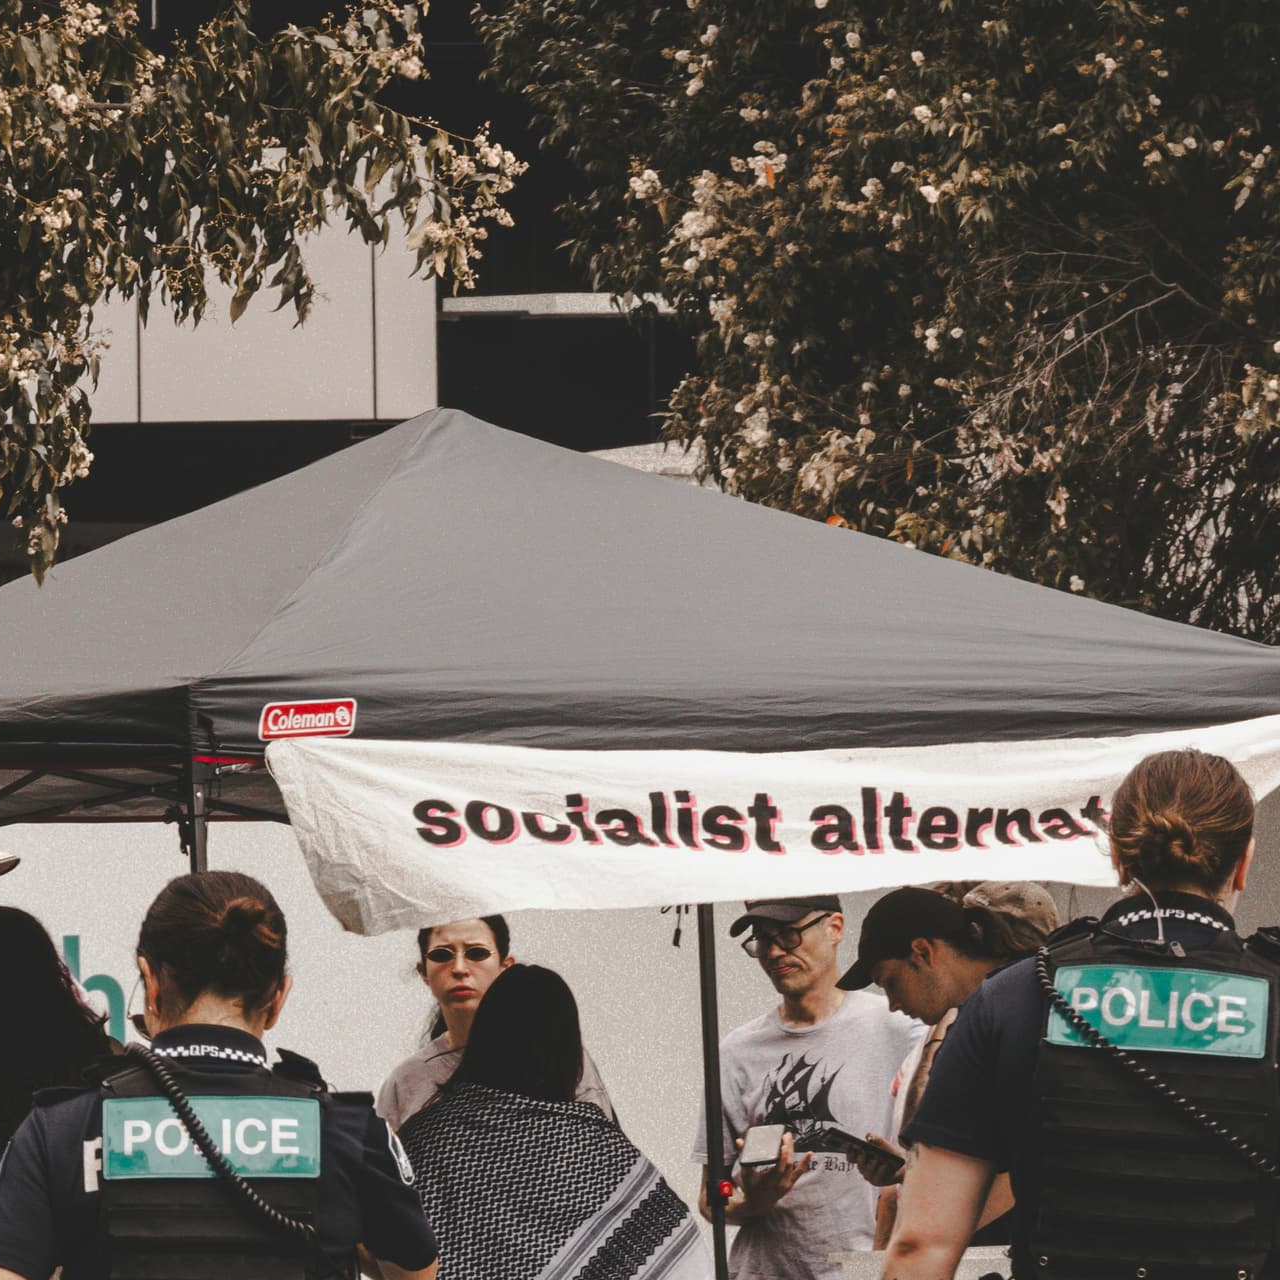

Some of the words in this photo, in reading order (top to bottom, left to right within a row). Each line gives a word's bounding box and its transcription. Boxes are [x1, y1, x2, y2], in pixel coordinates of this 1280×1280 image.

[267, 708, 335, 731] Coleman
[413, 789, 788, 856] socialist
[809, 786, 1110, 856] alternat
[1070, 986, 1248, 1035] POLICE
[189, 1044, 221, 1057] QPS
